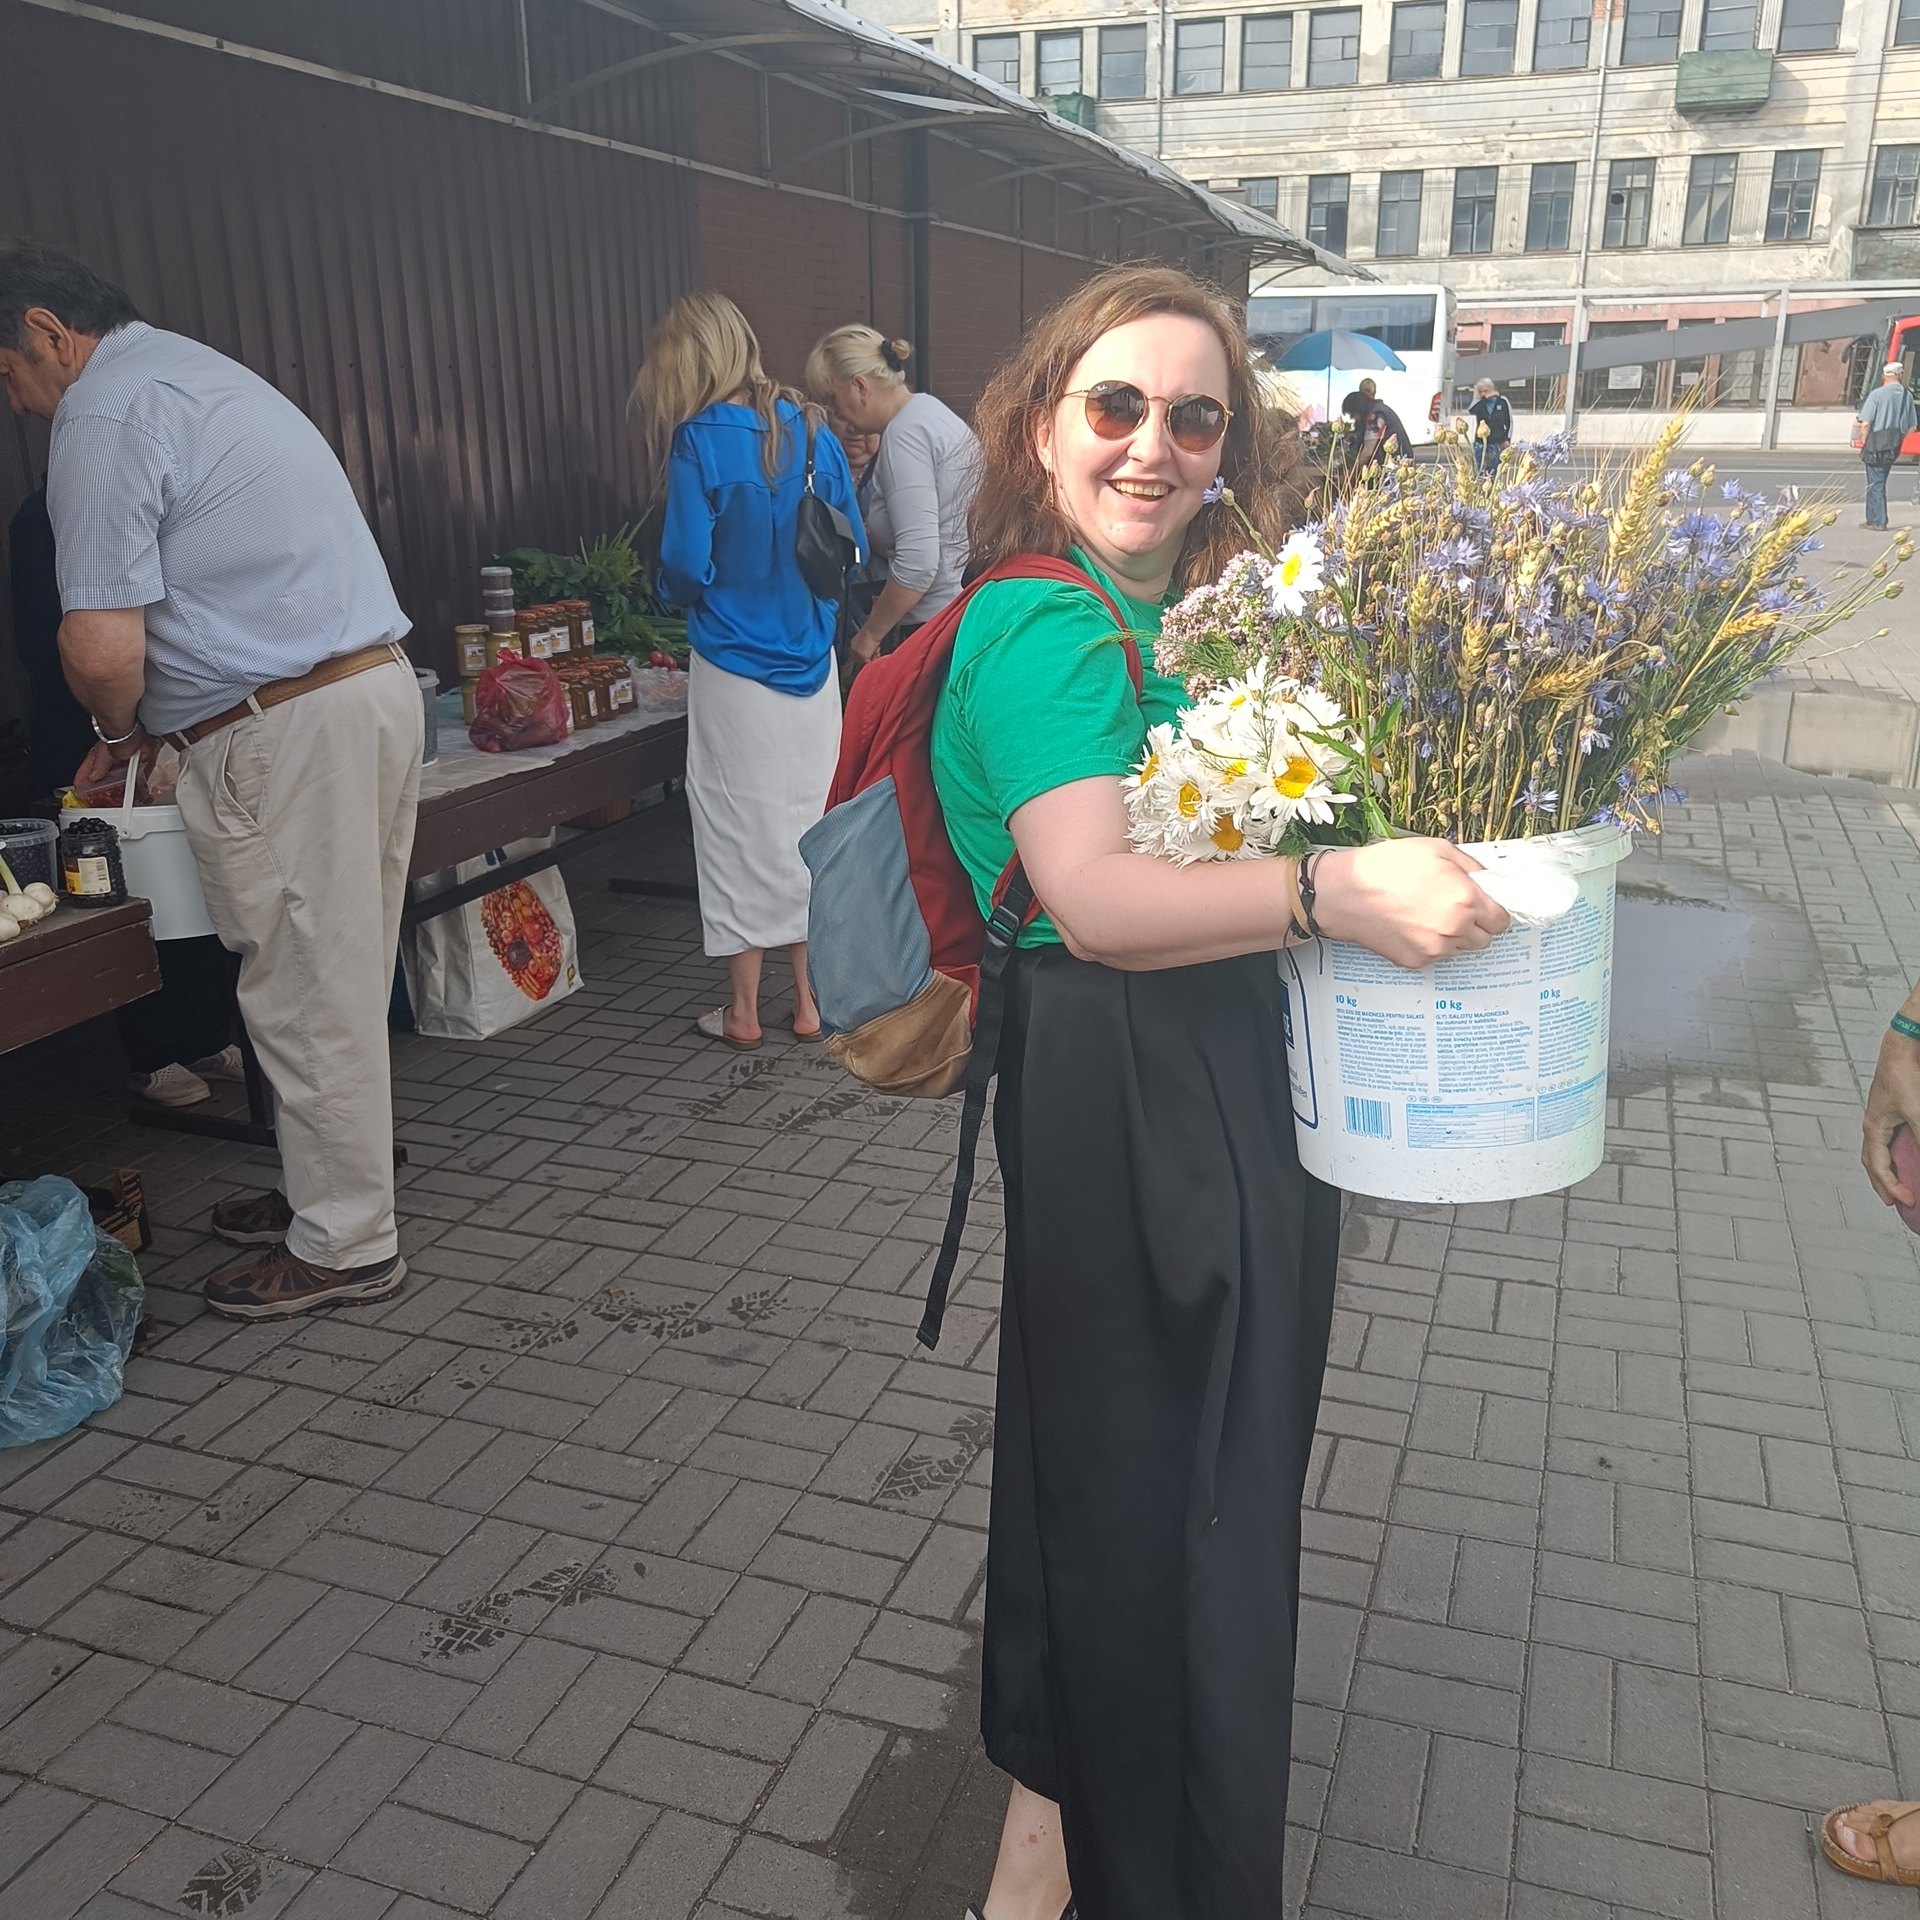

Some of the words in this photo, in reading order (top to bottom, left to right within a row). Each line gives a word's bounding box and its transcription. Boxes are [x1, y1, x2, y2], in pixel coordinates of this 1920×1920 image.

[1540, 989, 1549, 1000] 10
[1552, 989, 1560, 998] kg
[1336, 994, 1344, 1004] 10
[1347, 996, 1357, 1007] kg
[1435, 1000, 1446, 1009] 10
[1450, 1000, 1462, 1010] kg
